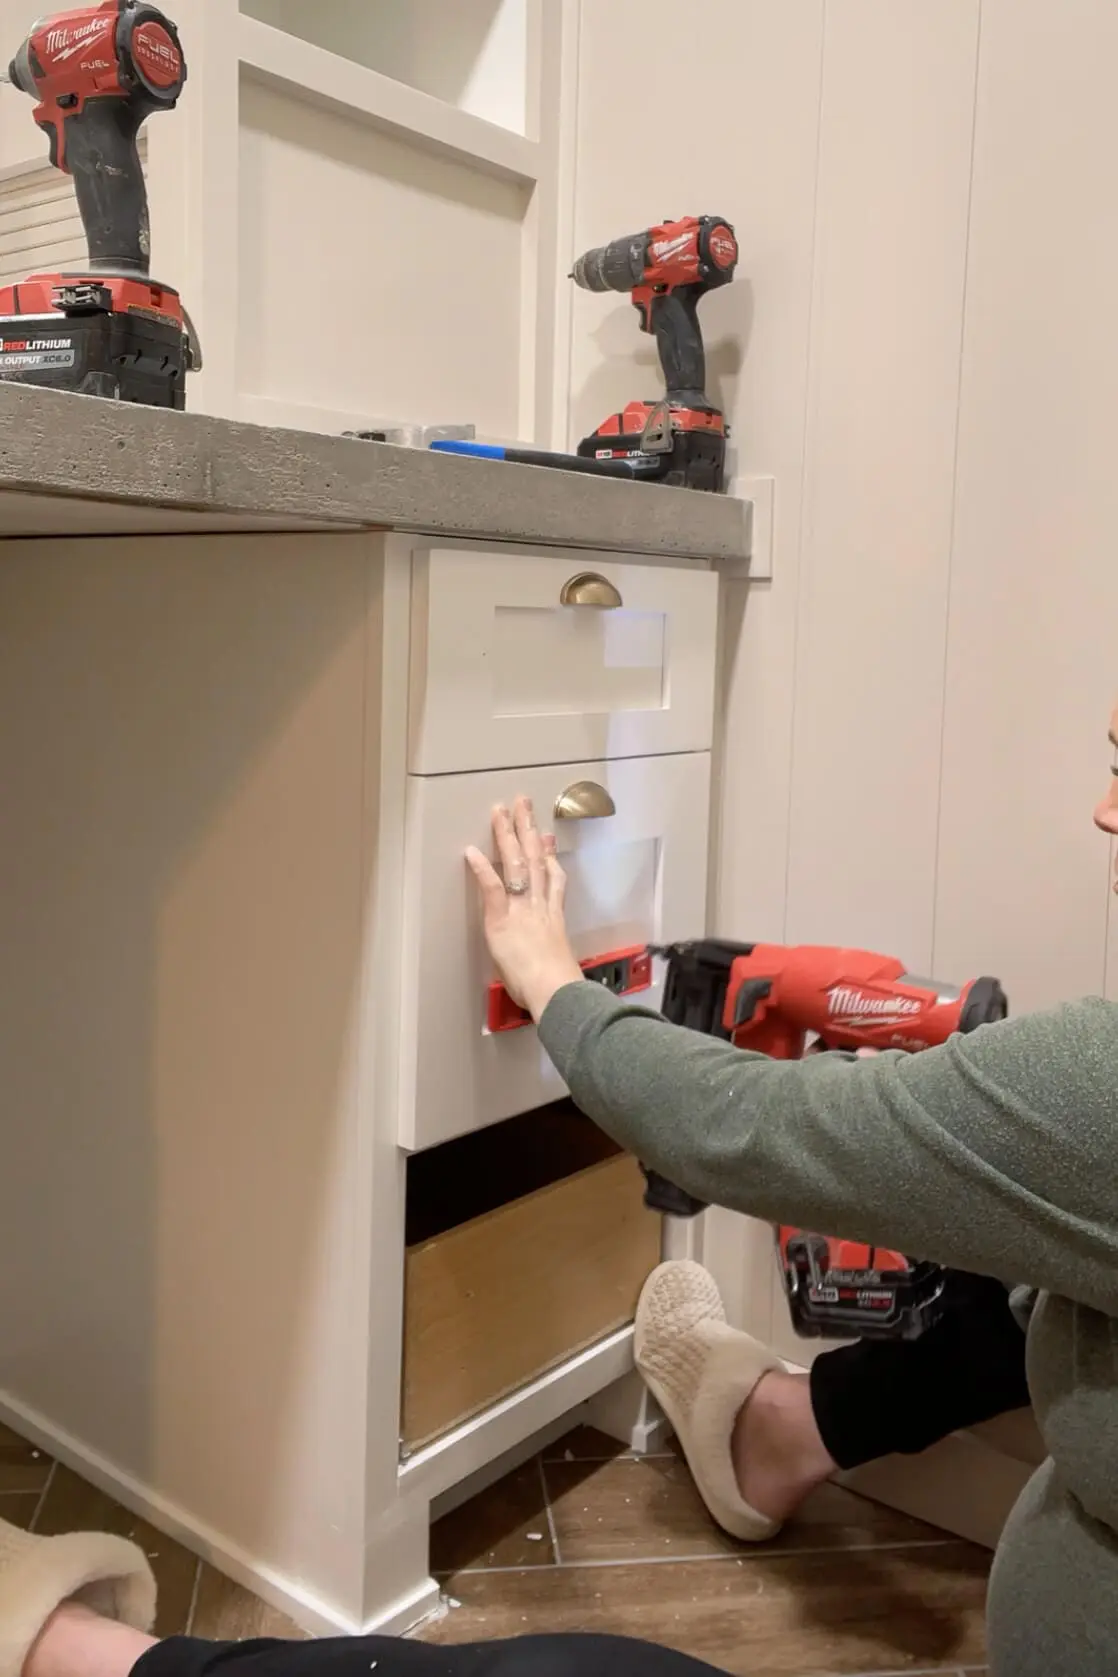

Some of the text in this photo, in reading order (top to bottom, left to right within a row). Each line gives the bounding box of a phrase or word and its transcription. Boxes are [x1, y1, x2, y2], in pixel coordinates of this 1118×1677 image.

[137, 33, 180, 65] FUEL
[80, 60, 110, 71] FUEL
[4, 338, 72, 351] REDLITHIUM
[4, 355, 42, 365] OUTPUT
[827, 986, 921, 1015] Milwaukee
